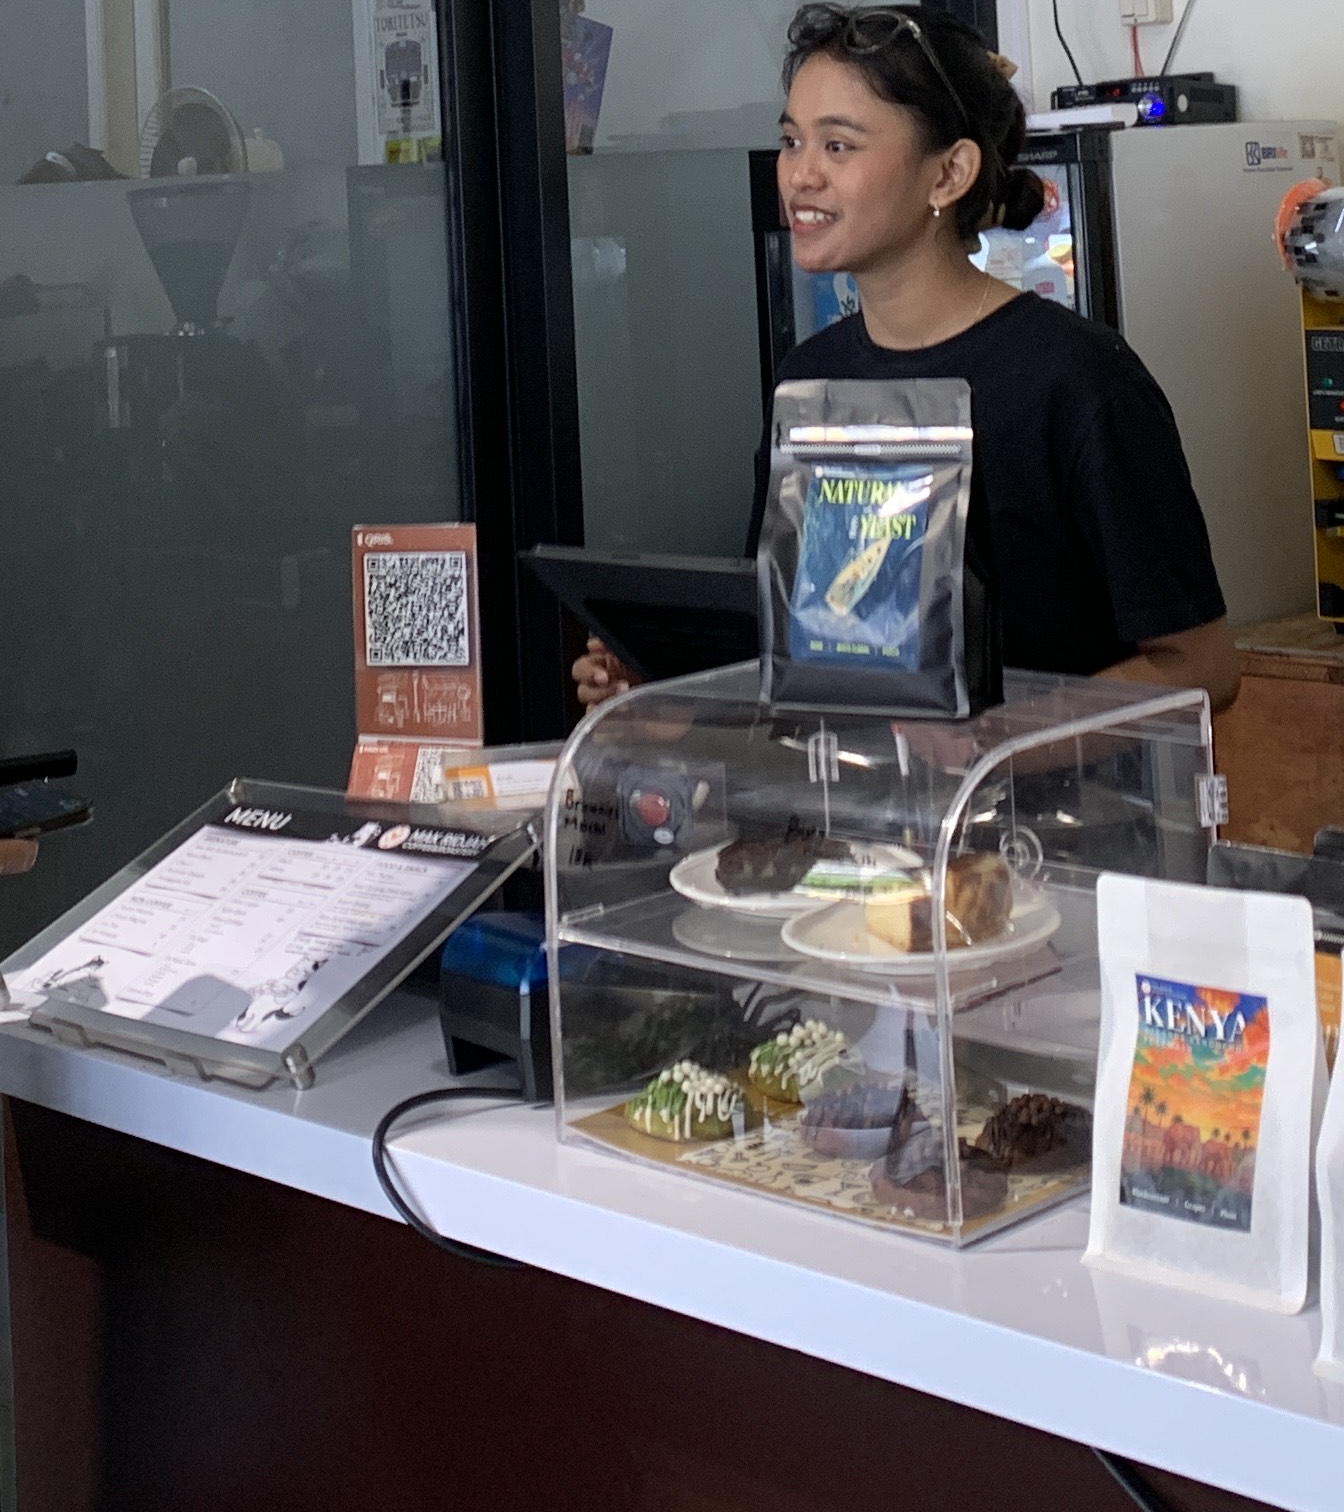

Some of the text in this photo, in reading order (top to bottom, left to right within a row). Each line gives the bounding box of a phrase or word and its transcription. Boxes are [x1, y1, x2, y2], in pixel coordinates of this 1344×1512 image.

[224, 806, 293, 831] MENU
[410, 828, 444, 845] MAK
[1143, 996, 1246, 1042] KENYA
